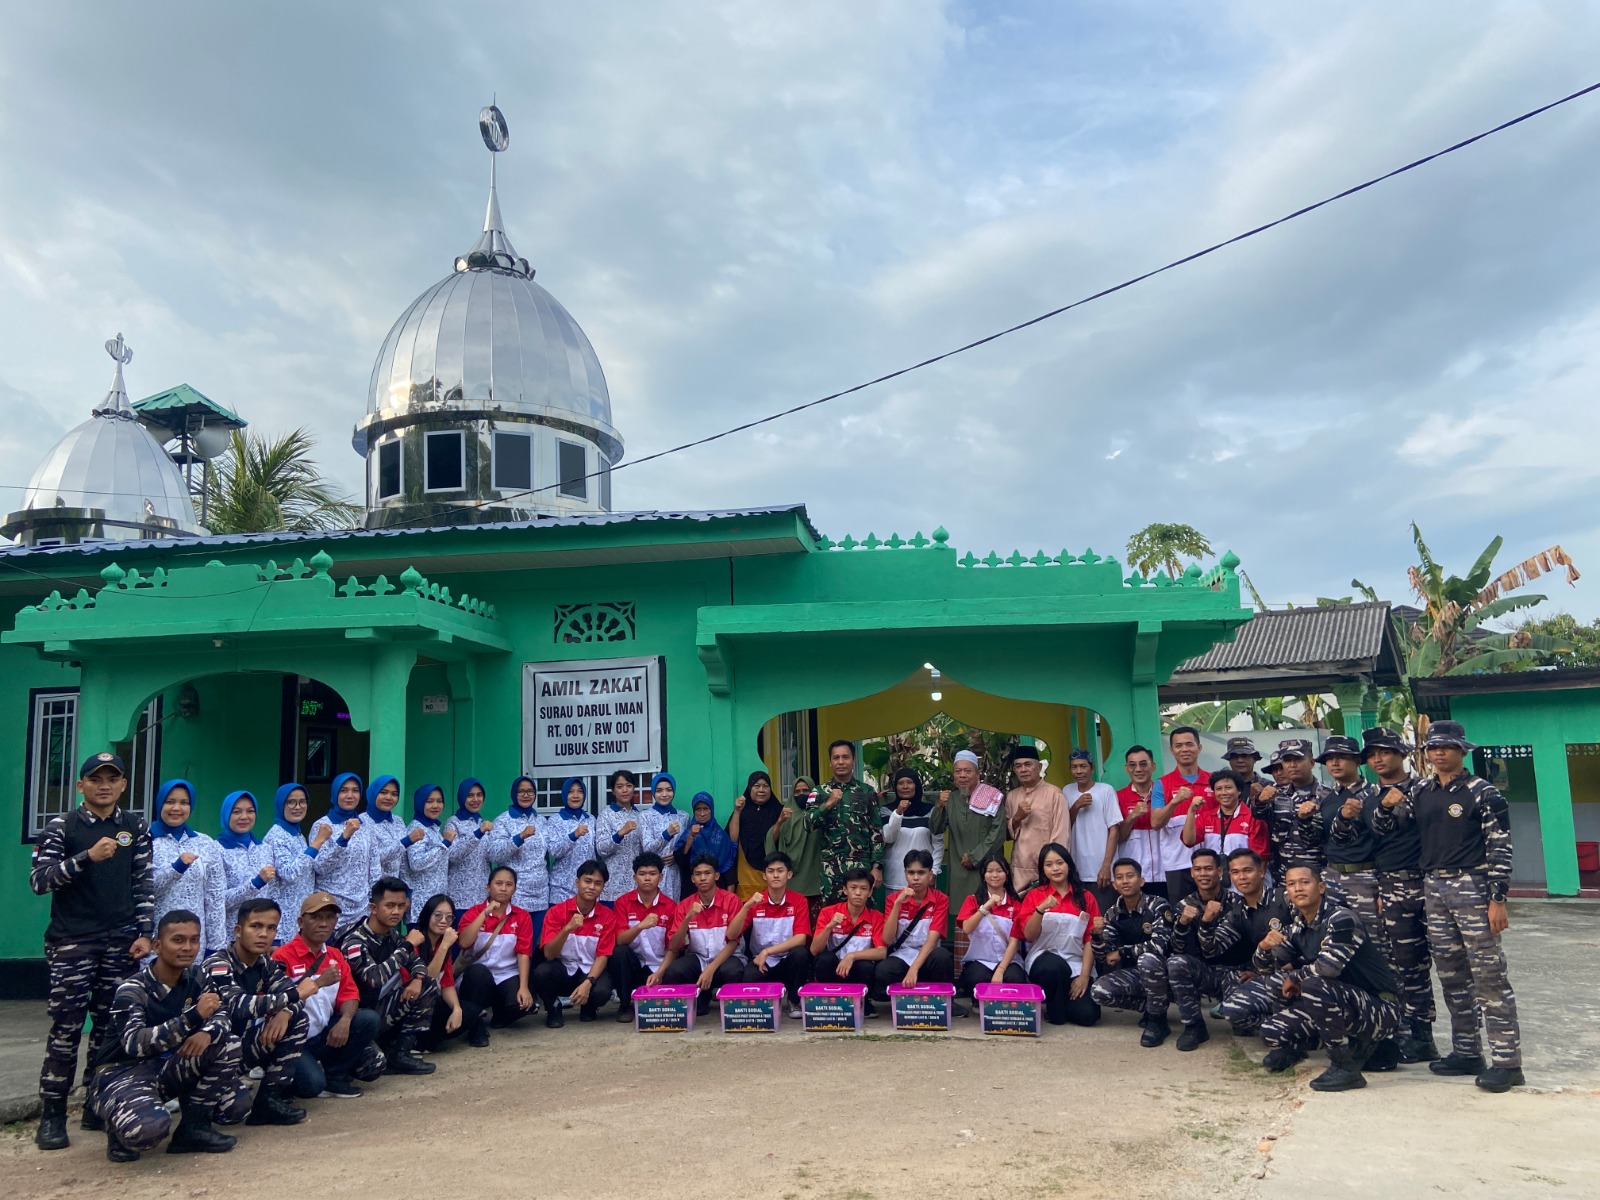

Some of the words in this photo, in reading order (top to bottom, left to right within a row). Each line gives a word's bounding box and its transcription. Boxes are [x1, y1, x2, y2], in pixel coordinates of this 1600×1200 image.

[541, 680, 583, 697] AMIL
[590, 676, 642, 695] ZAKAT
[540, 706, 573, 720] SURAU
[577, 704, 611, 718] DARUL
[615, 702, 643, 715] IMAN
[547, 724, 562, 738] RT.
[565, 724, 584, 737] 001
[587, 722, 592, 737] /
[595, 722, 612, 736] RW
[616, 720, 635, 734] 001
[555, 742, 589, 756] LUBUK
[592, 740, 629, 754] SEMUT
